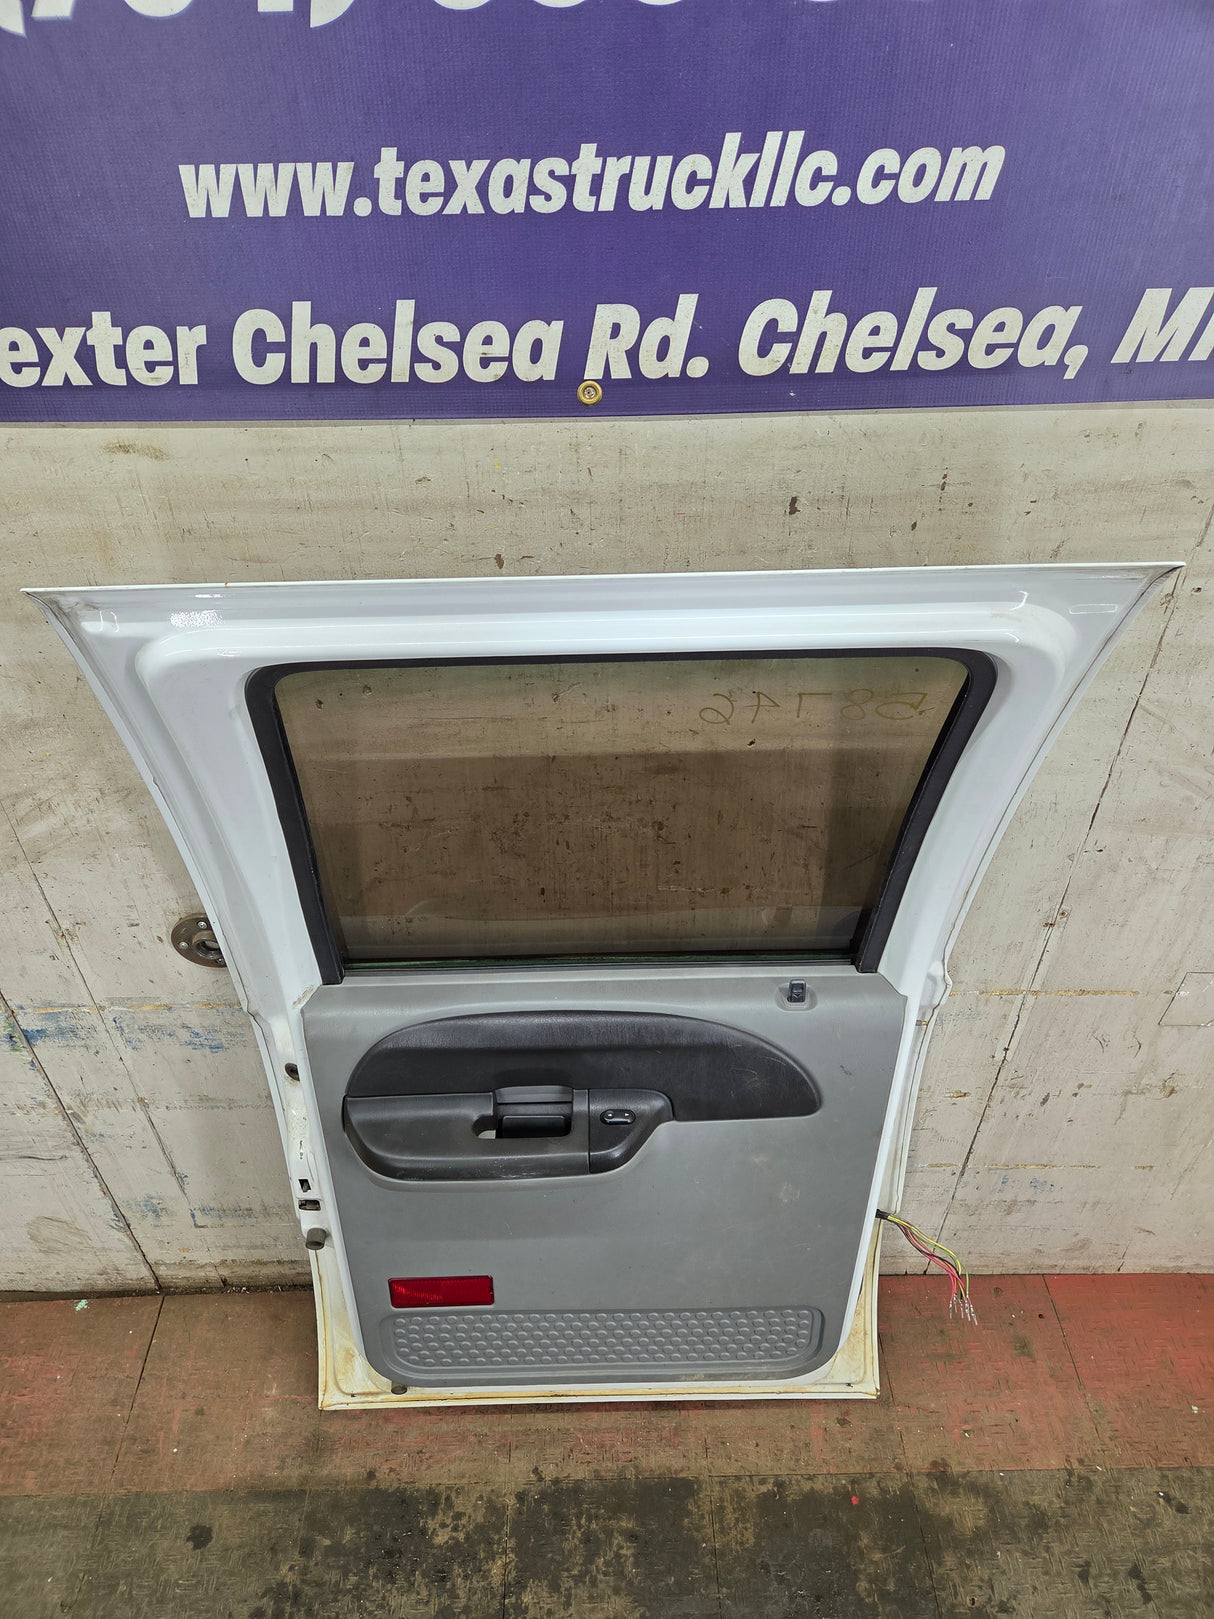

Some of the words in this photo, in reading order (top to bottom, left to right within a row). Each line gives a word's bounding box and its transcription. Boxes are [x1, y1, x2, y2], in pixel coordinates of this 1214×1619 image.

[179, 130, 1006, 218] www.texastruckllc.com
[232, 299, 565, 385] Chelsea
[583, 293, 710, 380] Rd.
[738, 286, 1089, 380] Chelsea,
